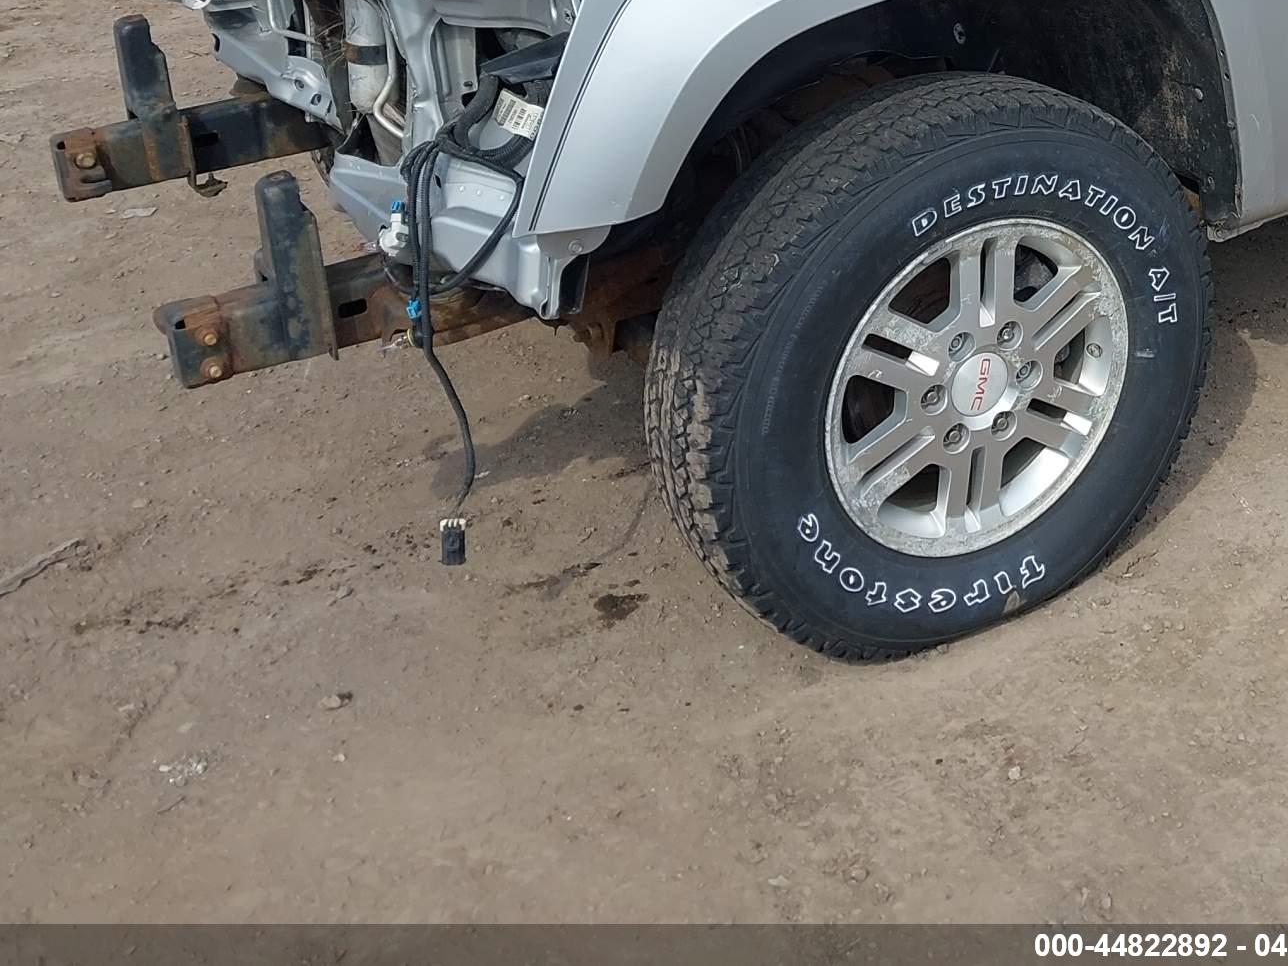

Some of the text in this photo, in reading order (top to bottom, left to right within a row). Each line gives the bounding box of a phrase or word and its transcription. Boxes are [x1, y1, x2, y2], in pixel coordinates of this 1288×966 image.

[911, 174, 1178, 324] DESTINATION A/T
[971, 358, 990, 411] GMC
